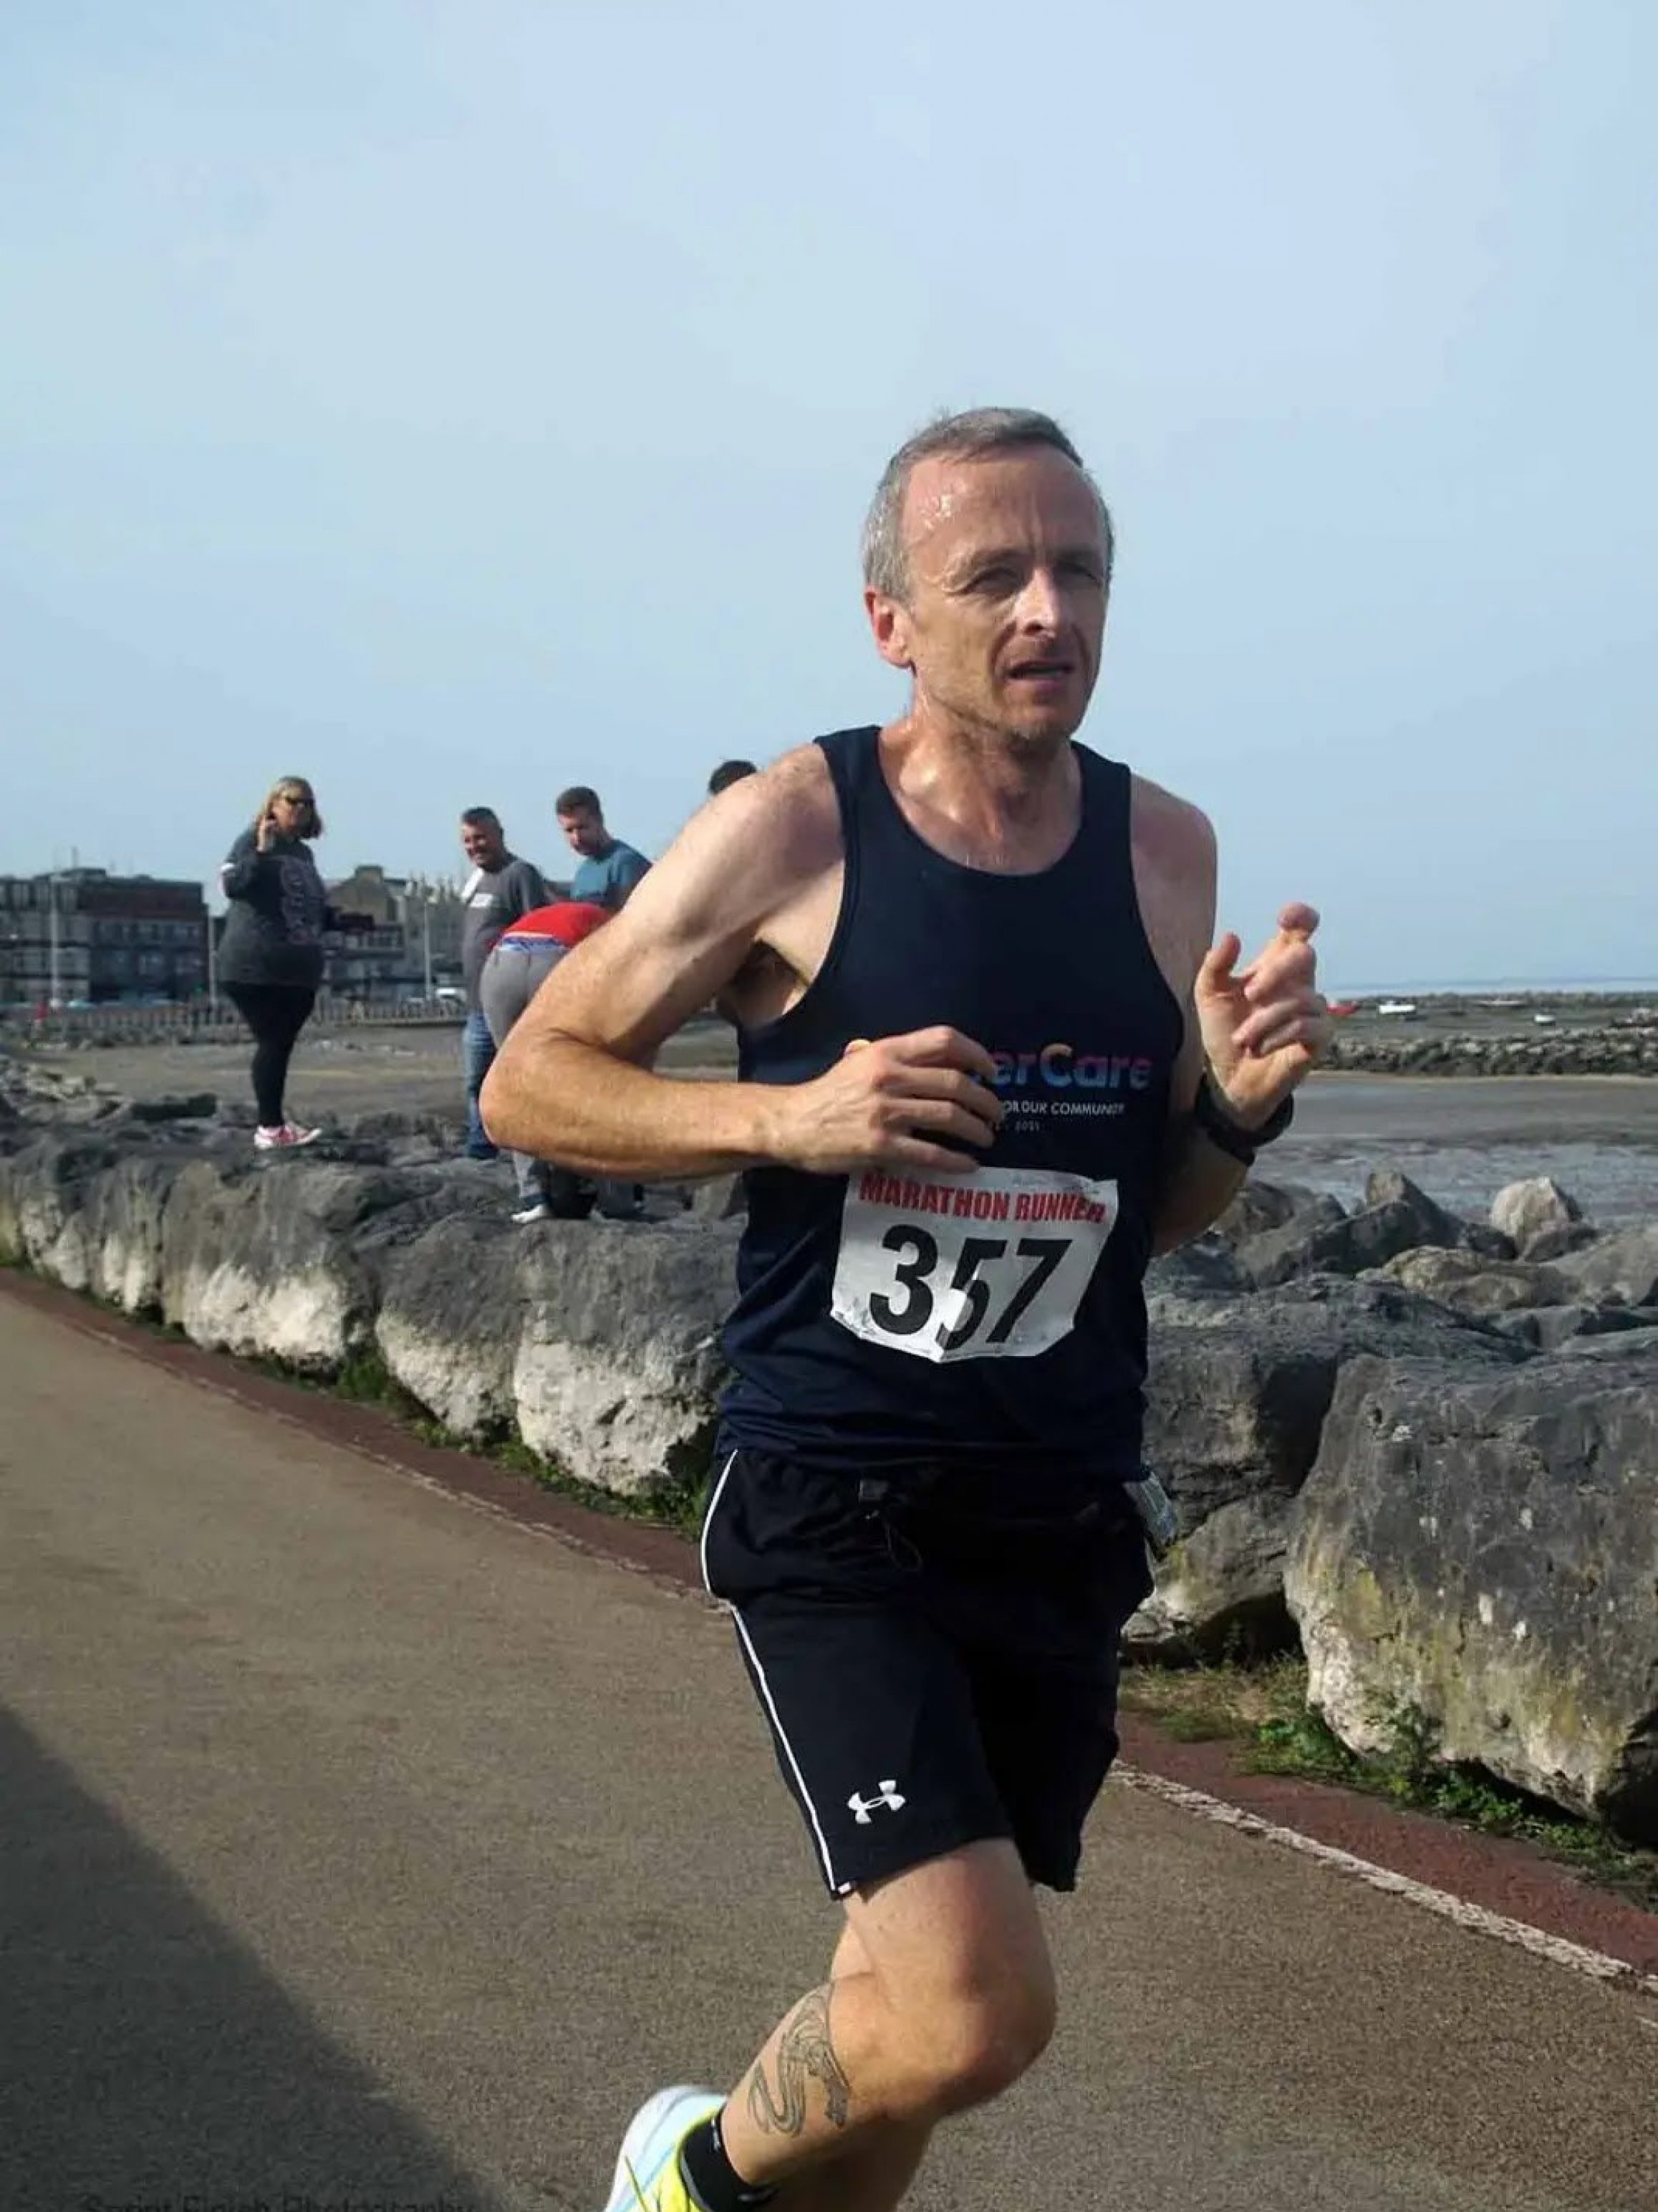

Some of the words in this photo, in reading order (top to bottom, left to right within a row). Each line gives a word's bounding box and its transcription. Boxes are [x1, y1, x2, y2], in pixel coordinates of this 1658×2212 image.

[988, 1043, 1152, 1089] erCare
[1002, 1100, 1020, 1114] OR
[860, 1173, 1011, 1221] MARATHON
[1015, 1192, 1106, 1223] RUNNER
[869, 1224, 1074, 1350] 357
